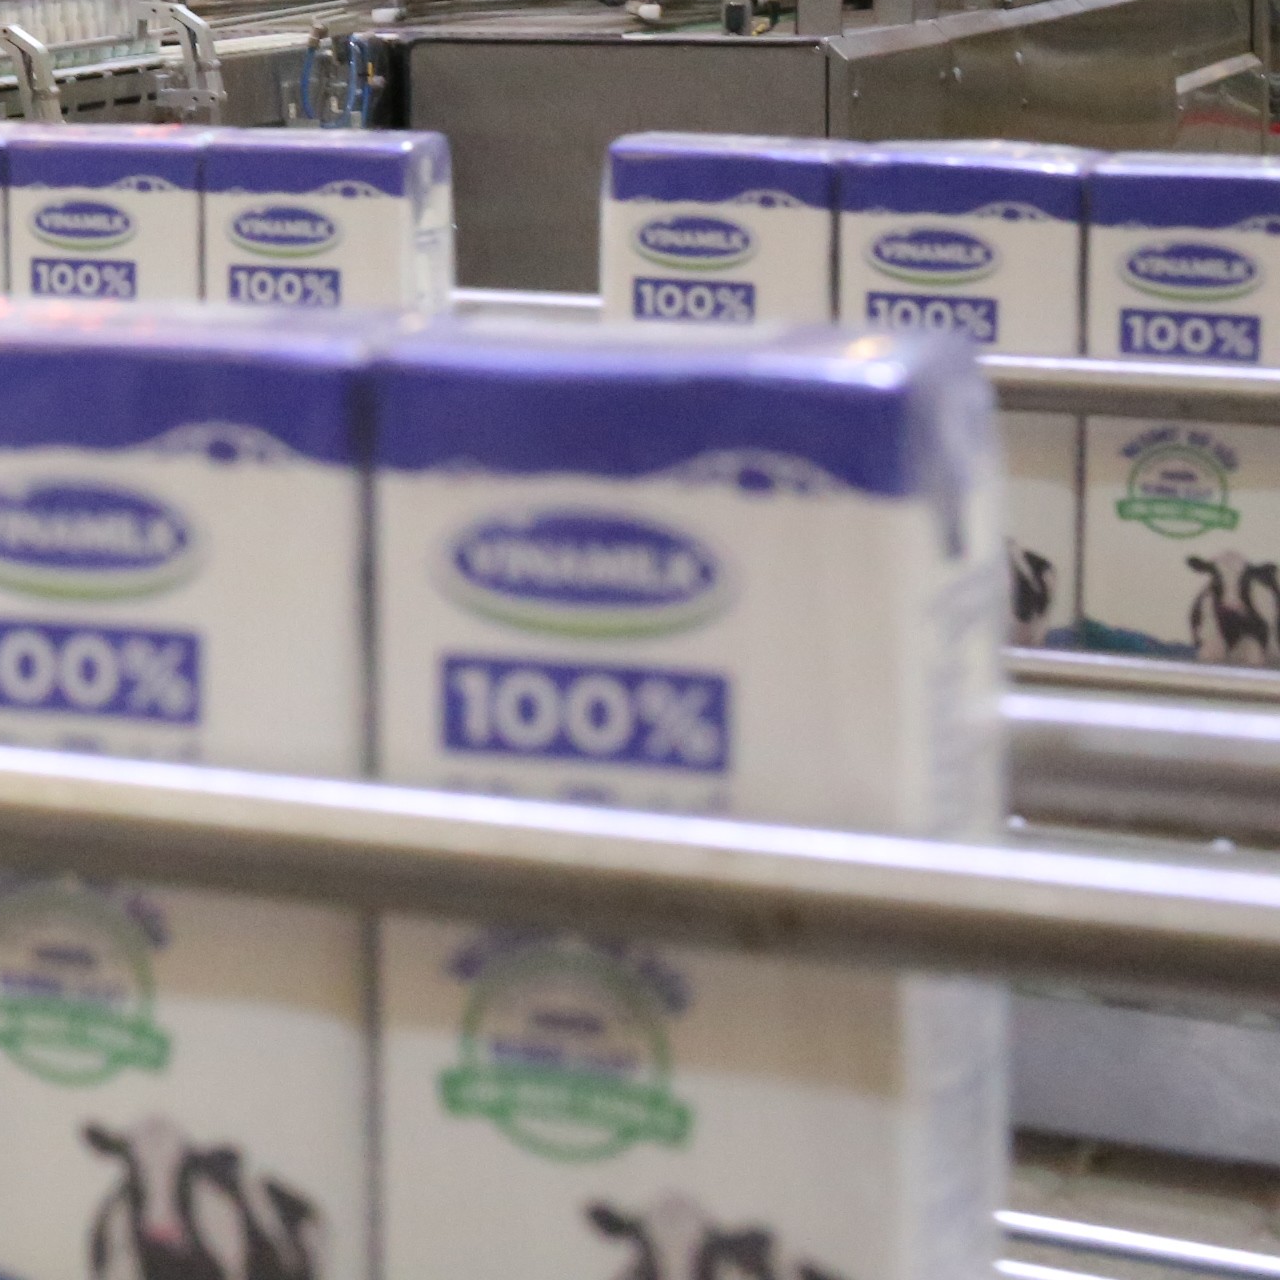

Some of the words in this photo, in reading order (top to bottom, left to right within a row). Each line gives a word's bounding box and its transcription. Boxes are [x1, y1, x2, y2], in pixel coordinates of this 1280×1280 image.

[37, 210, 127, 231] VINAMILK
[236, 216, 332, 239] VINAMILK
[643, 227, 748, 250] VINAMILK
[878, 239, 989, 265] VINAMILK
[35, 261, 134, 297] 100%
[1131, 255, 1251, 281] VINAMILK
[234, 269, 338, 305] 100%
[638, 283, 752, 321] 100%
[1125, 315, 1254, 359] 100%
[453, 670, 721, 768] 100%
